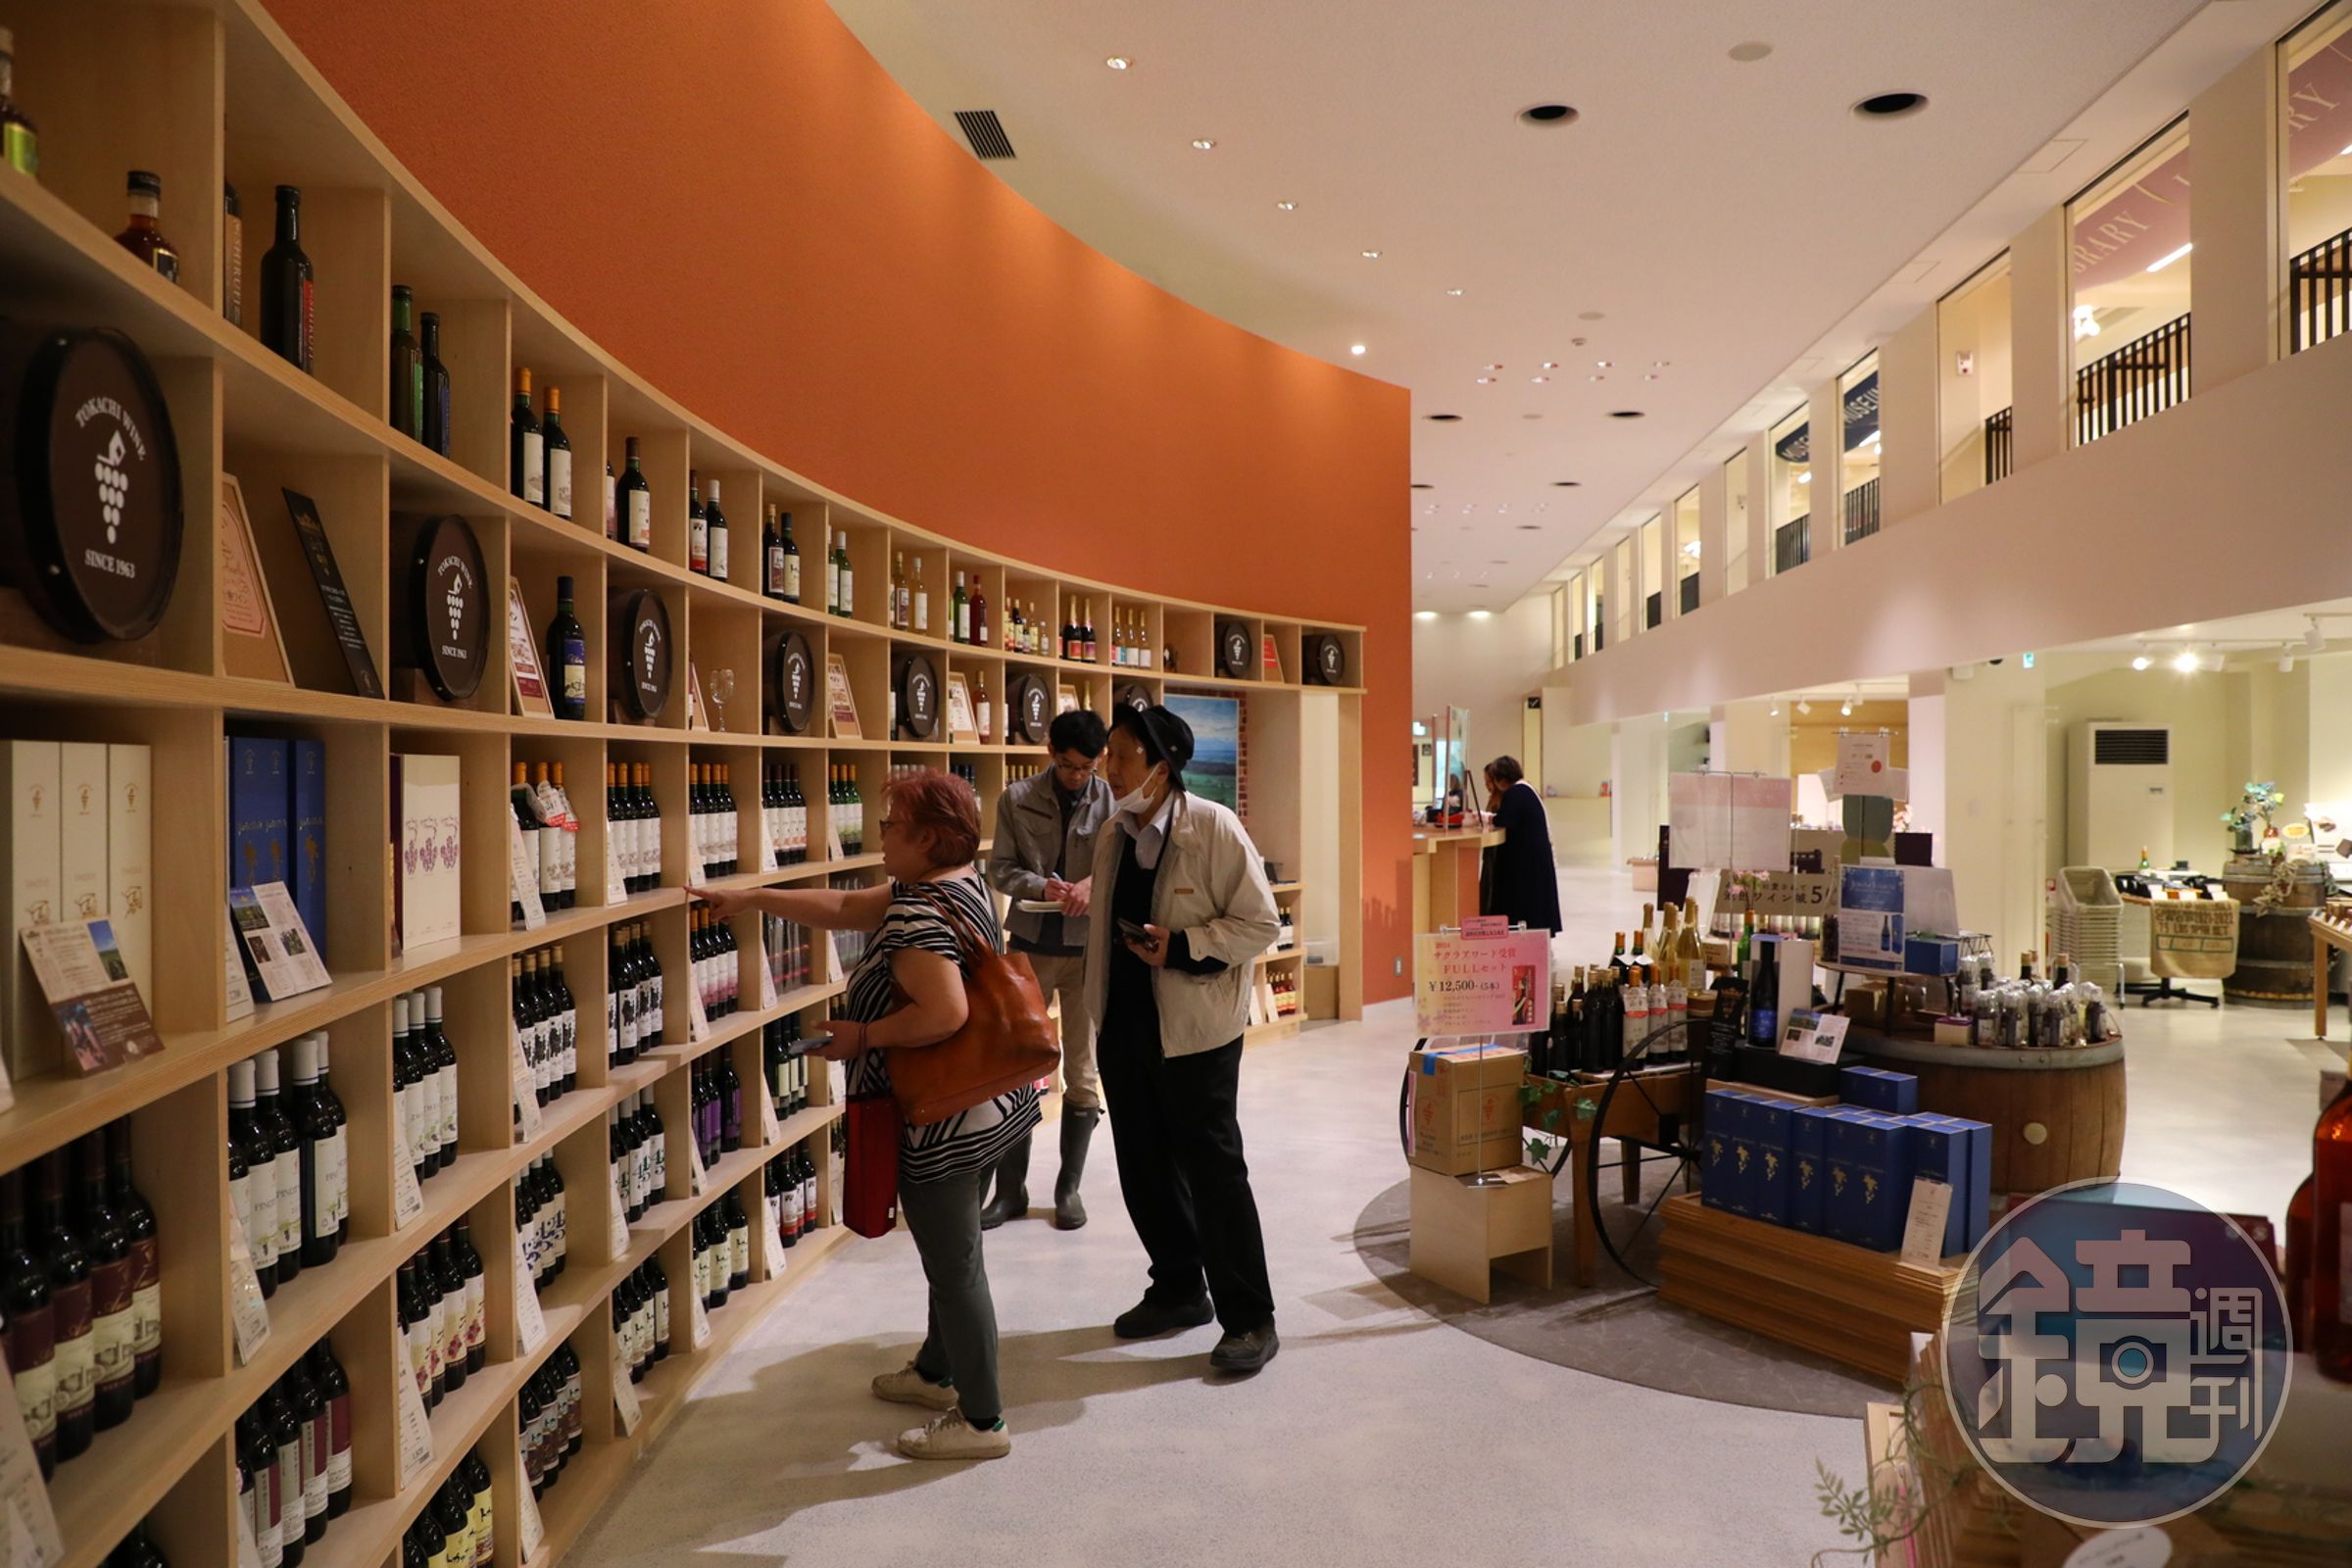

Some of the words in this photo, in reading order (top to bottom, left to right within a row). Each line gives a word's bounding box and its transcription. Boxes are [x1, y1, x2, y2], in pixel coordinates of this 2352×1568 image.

[75, 397, 122, 428] TOKACHI
[122, 410, 146, 461] WINE
[85, 549, 115, 572] SINCE
[116, 558, 135, 579] 1963
